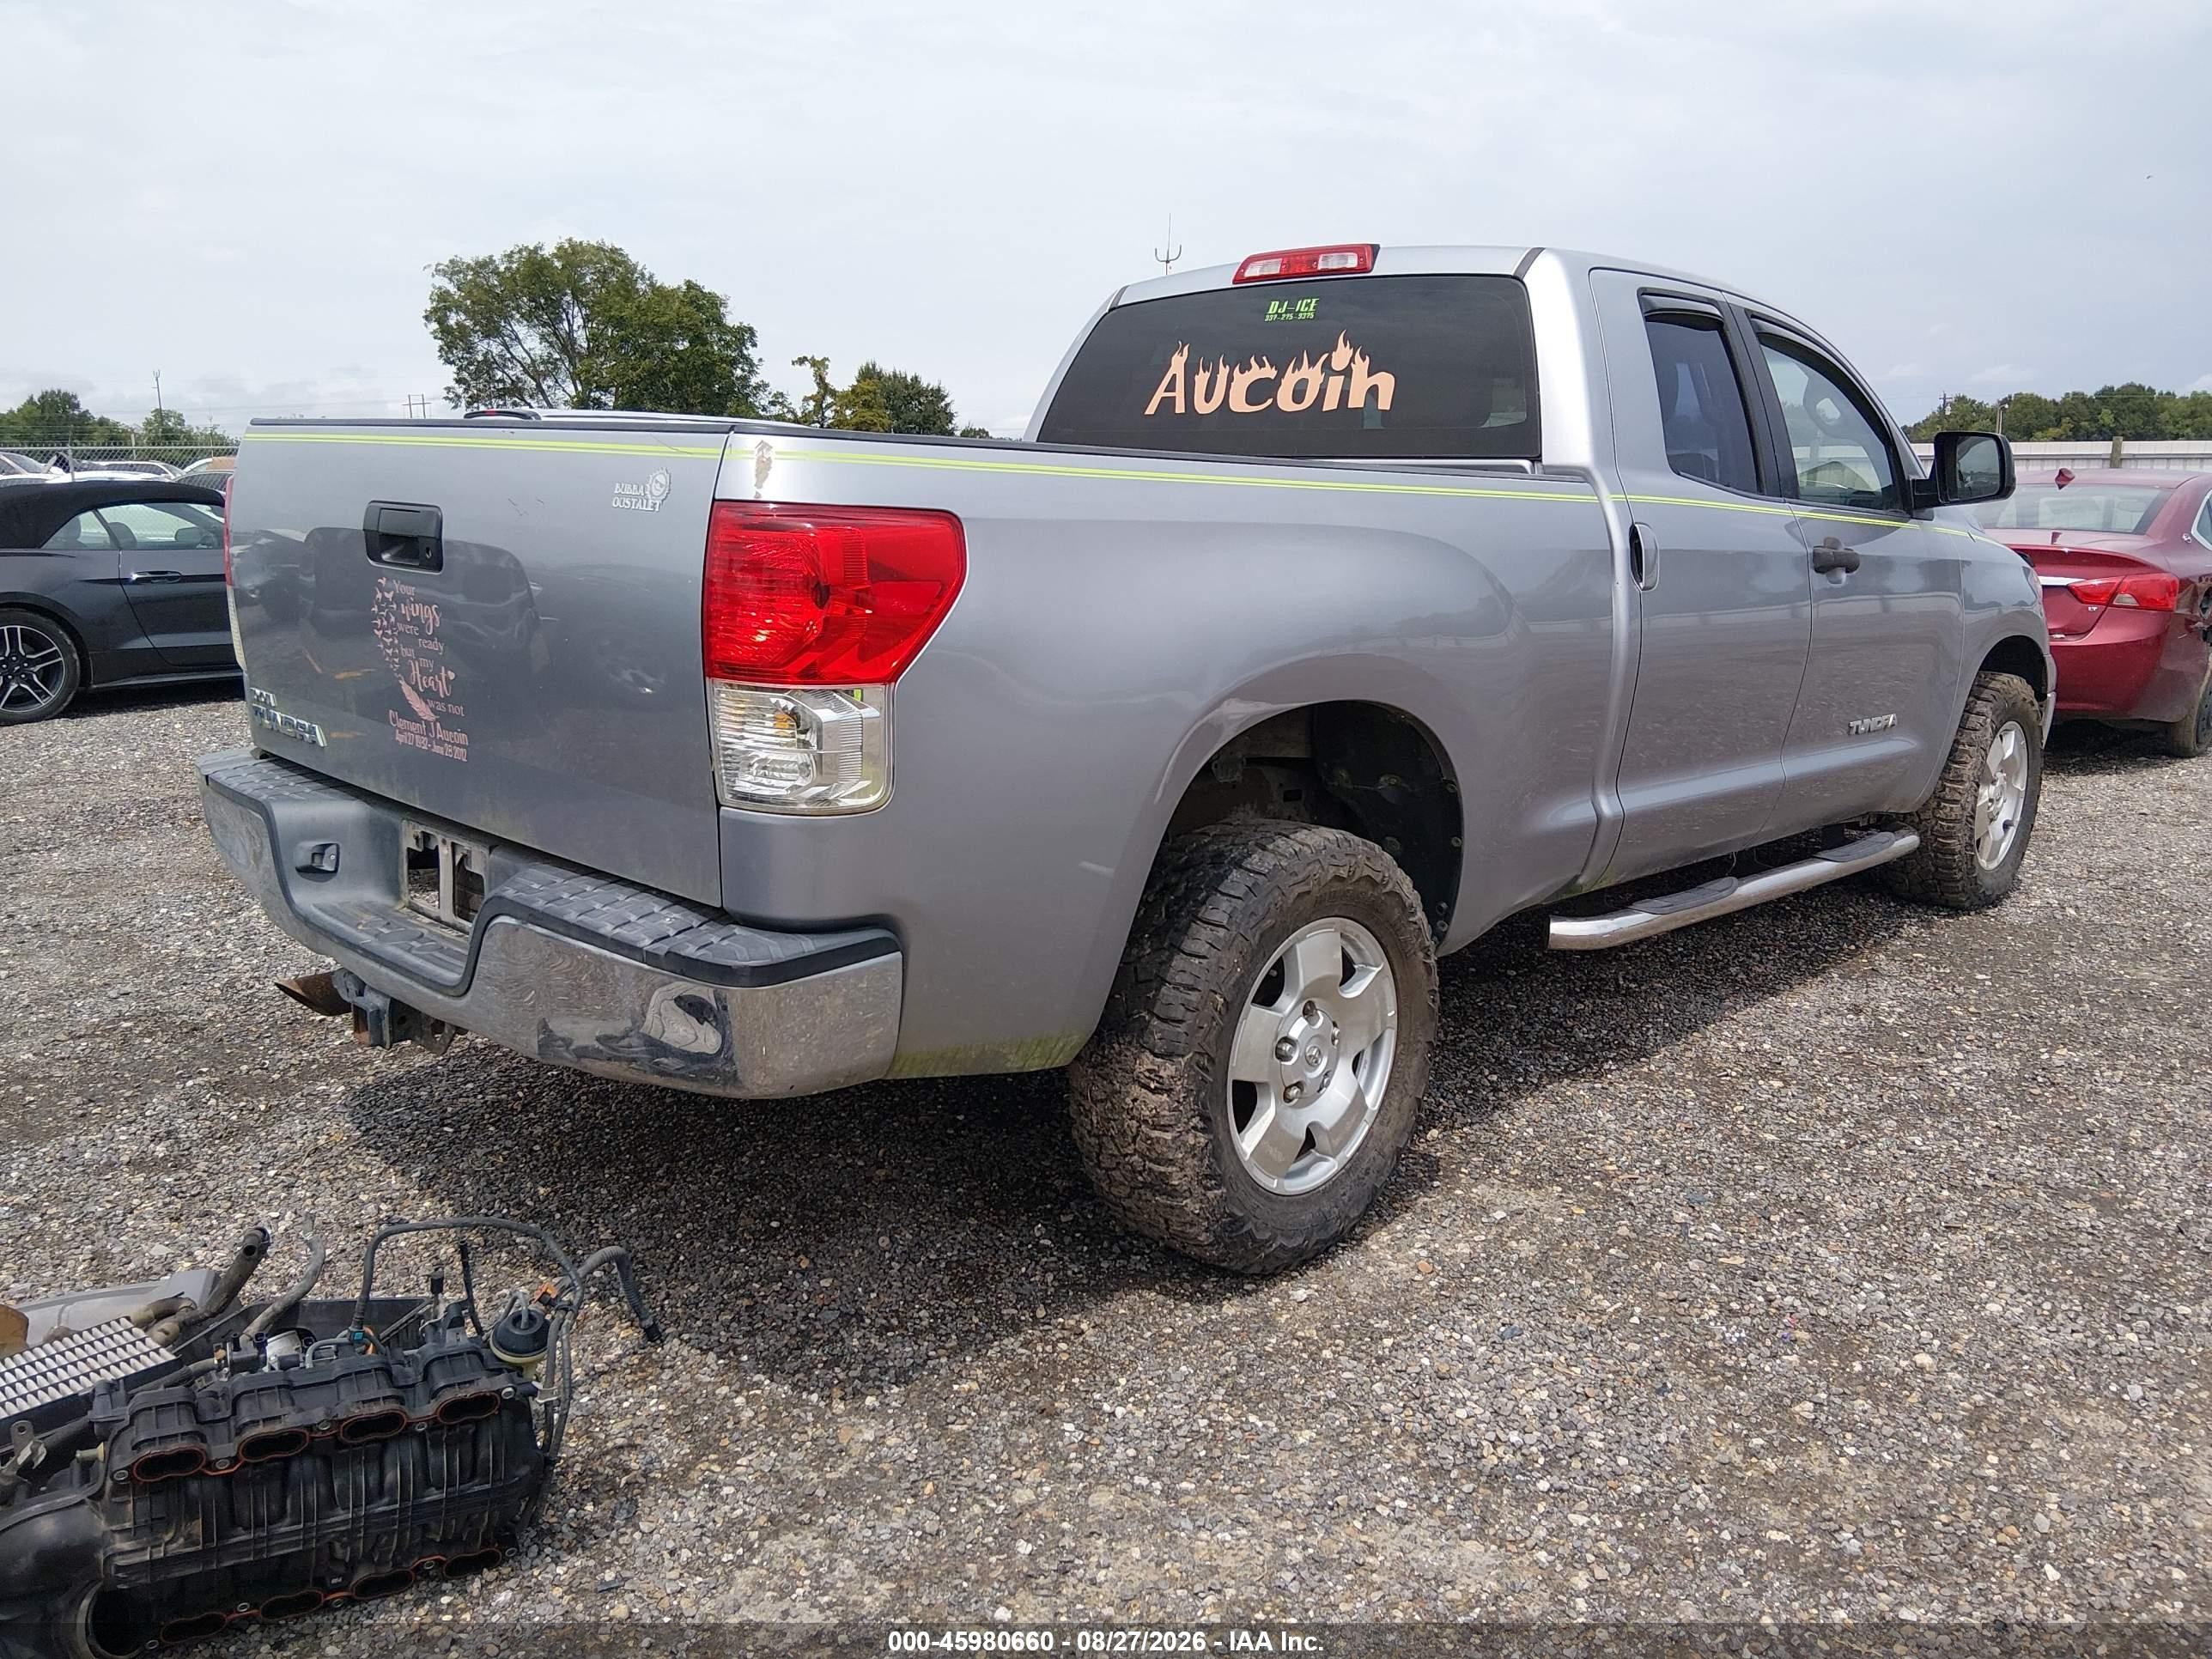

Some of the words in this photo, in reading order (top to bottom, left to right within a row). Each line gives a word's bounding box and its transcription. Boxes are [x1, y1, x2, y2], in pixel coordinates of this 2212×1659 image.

[1267, 298, 1320, 314] DJ-ICE
[1144, 329, 1395, 415] Aucoin
[612, 496, 661, 512] OUSTALET
[392, 579, 416, 595] Your
[400, 597, 441, 635] wings
[397, 620, 419, 635] were
[400, 644, 416, 659] but
[418, 637, 445, 655] ready
[419, 657, 434, 672] my
[408, 659, 453, 698] Heart
[428, 698, 447, 712] was
[447, 702, 465, 717] not
[389, 709, 427, 736] Clement
[429, 721, 435, 738] J
[436, 721, 469, 745] Aucoin
